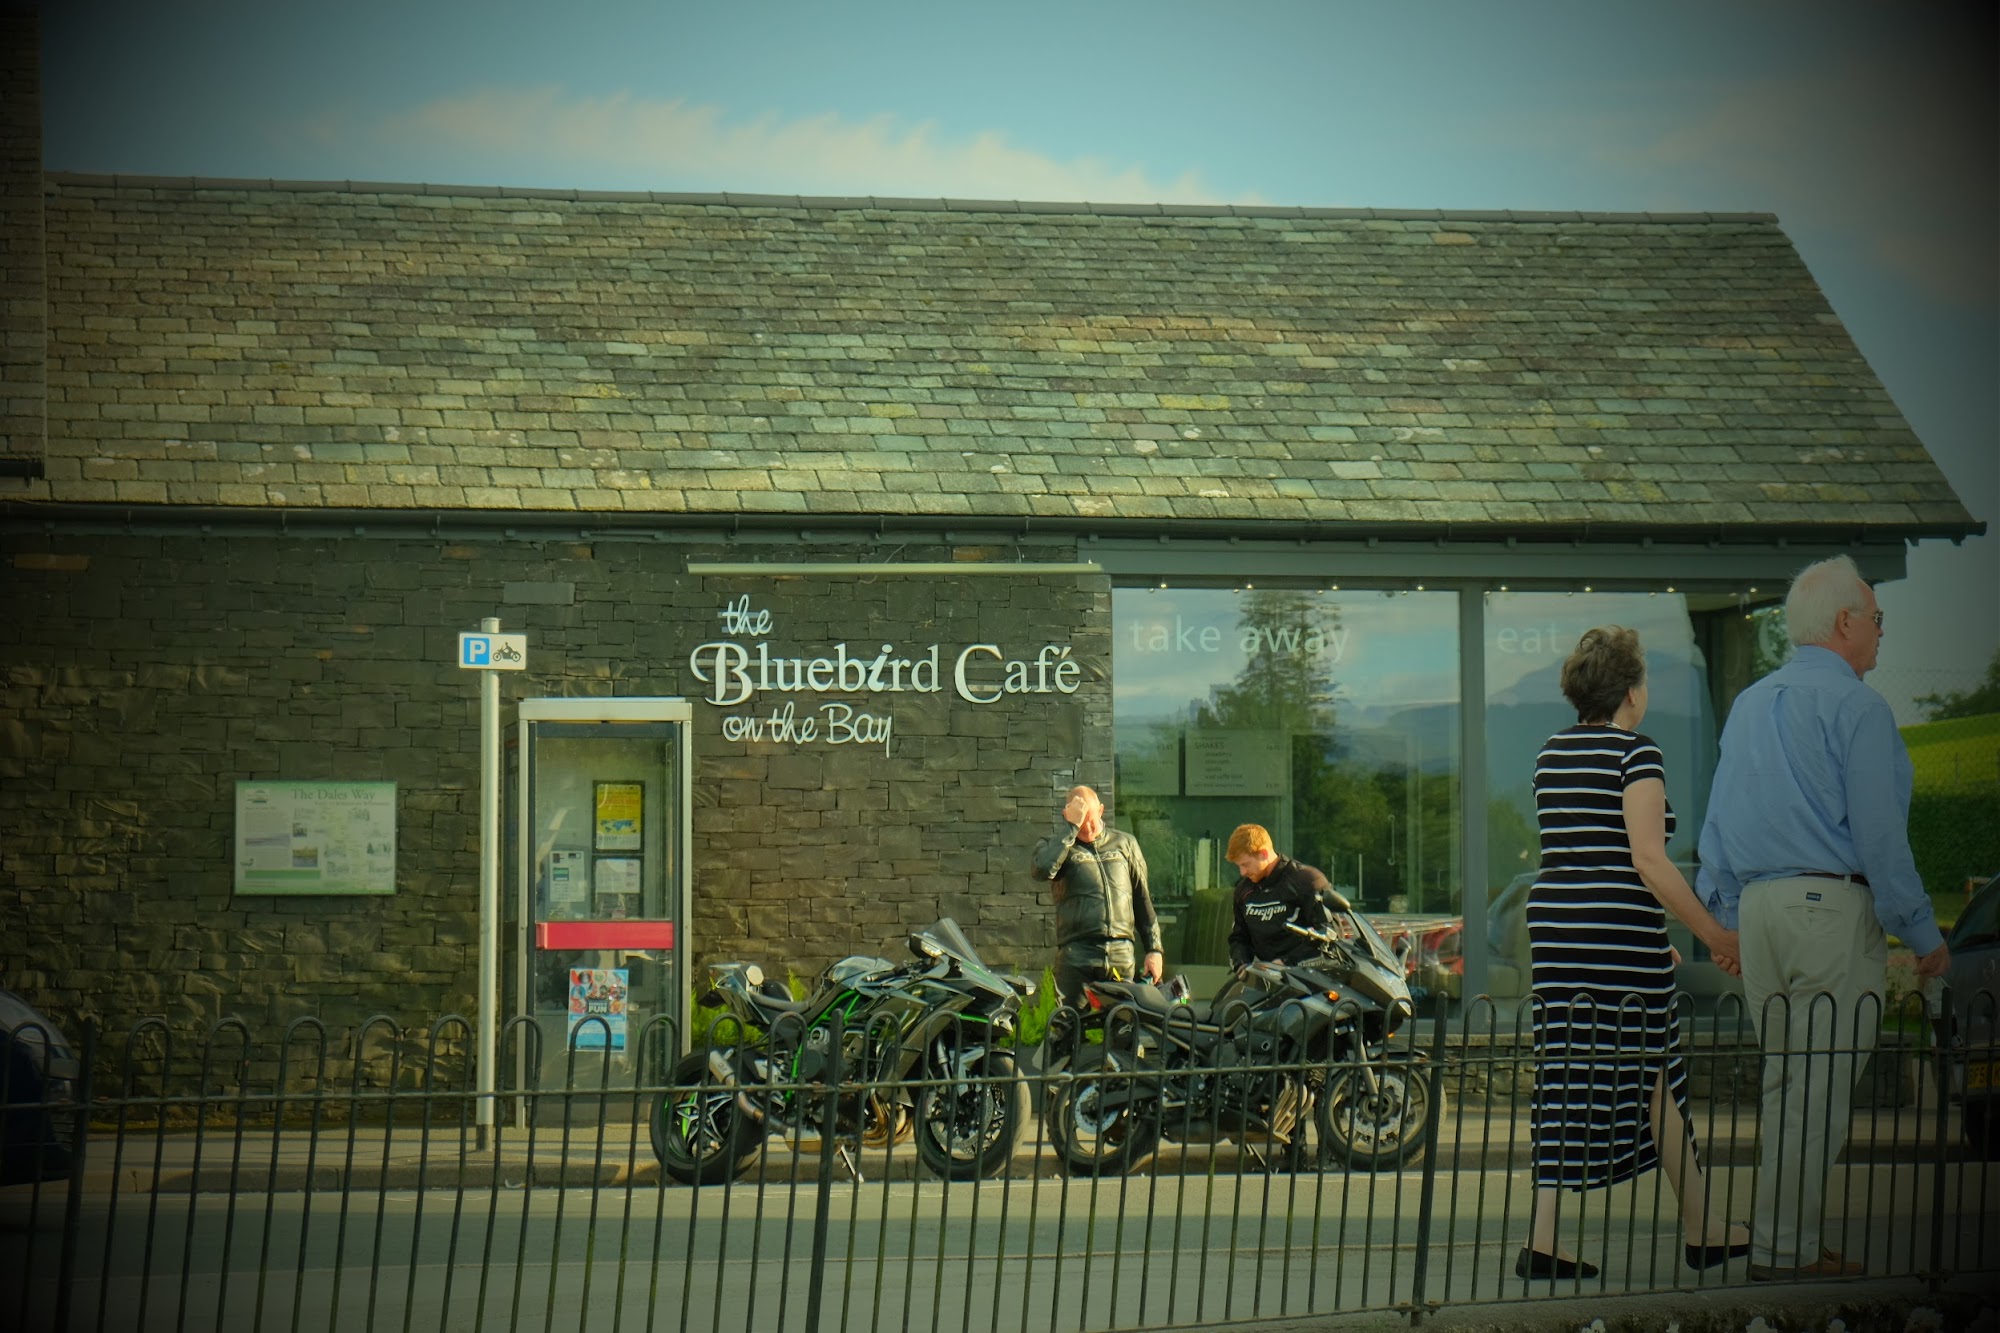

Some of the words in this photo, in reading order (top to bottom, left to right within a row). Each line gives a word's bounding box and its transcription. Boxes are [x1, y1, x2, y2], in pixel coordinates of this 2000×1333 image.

[723, 594, 773, 636] the
[470, 640, 486, 663] P
[1129, 614, 1221, 653] take
[1239, 624, 1349, 662] away
[1498, 627, 1560, 654] eat
[690, 642, 942, 706] Bluebird
[954, 644, 1081, 704] Café
[723, 715, 763, 742] on
[767, 701, 818, 745] the
[820, 704, 892, 758] Bay
[291, 788, 314, 800] The
[318, 789, 348, 800] Dales
[352, 788, 376, 802] Way
